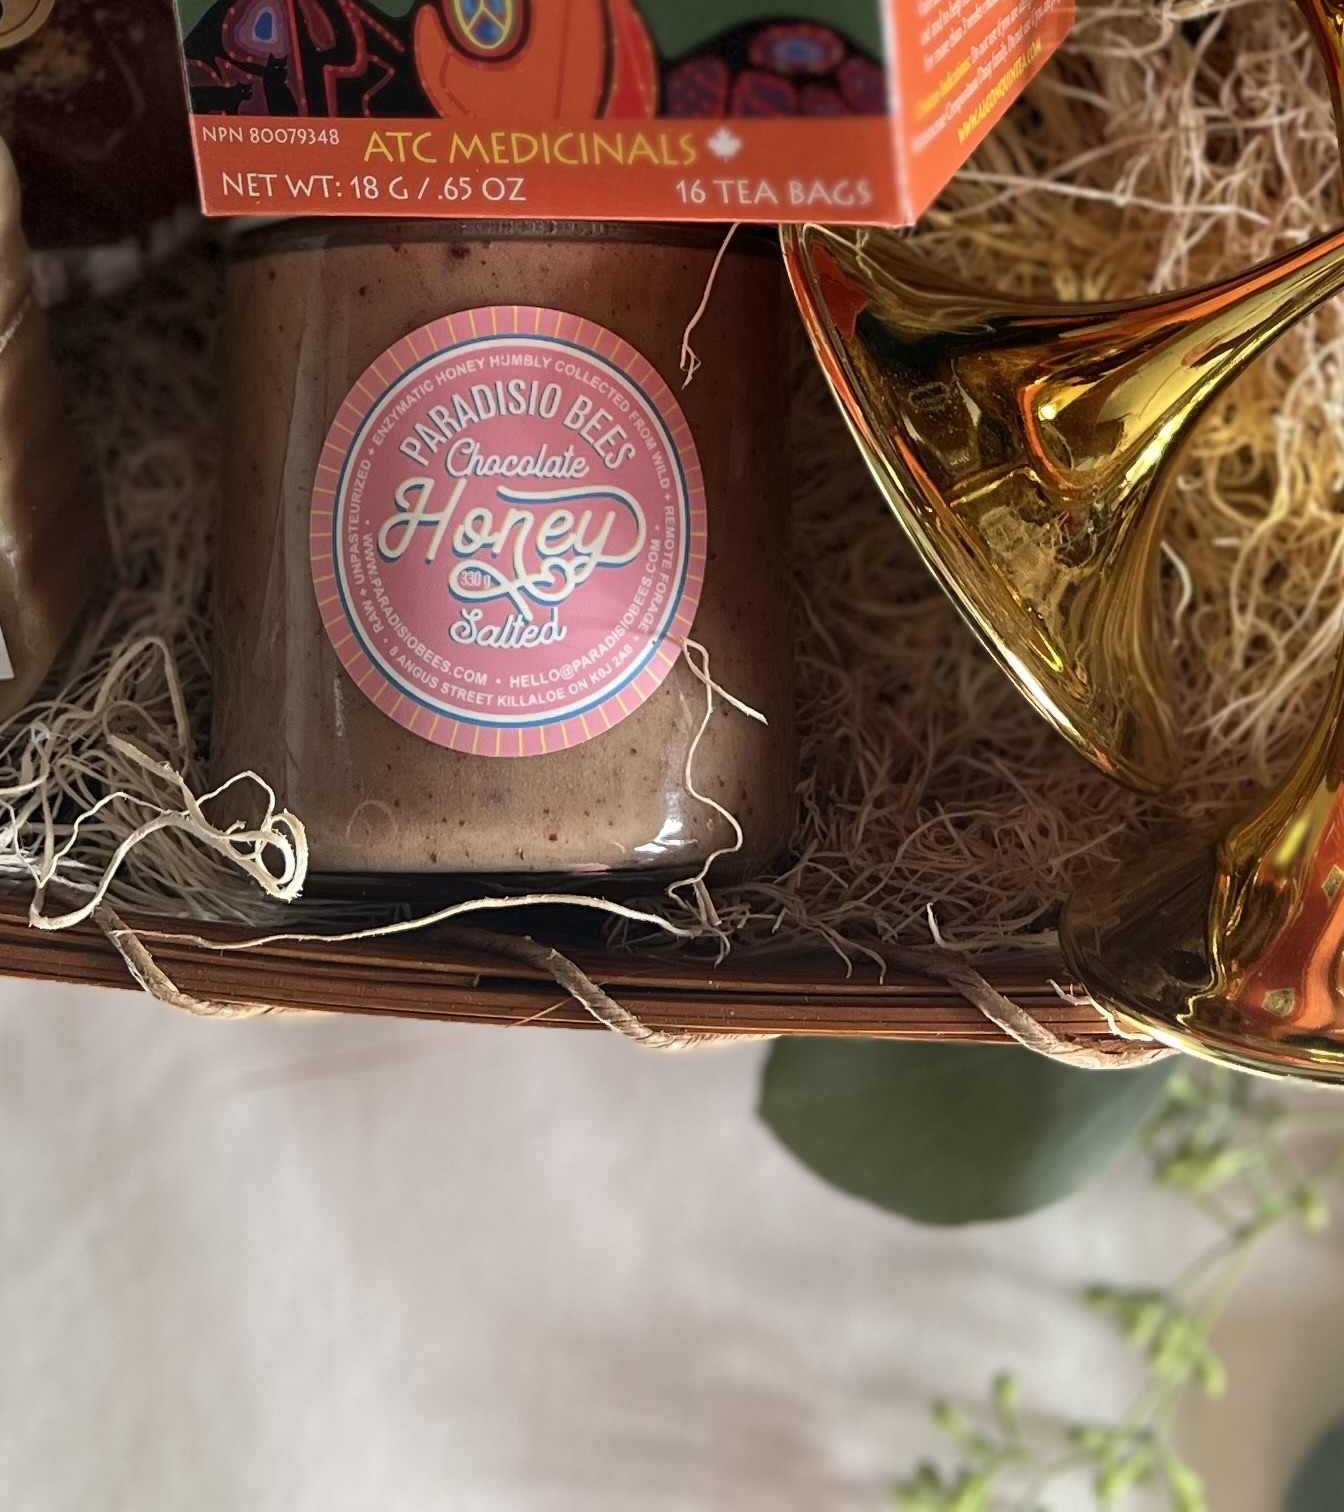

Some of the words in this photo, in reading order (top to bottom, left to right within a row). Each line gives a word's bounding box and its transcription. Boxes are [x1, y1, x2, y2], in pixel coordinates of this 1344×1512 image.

[202, 126, 243, 143] NPN
[250, 127, 340, 145] 80079348
[364, 131, 437, 164] ATC
[449, 132, 697, 166] MEDICINALS
[222, 173, 277, 197] NET
[285, 174, 343, 198] WT:
[350, 176, 379, 199] 18
[389, 176, 409, 200] G
[437, 177, 472, 200] .65
[482, 177, 527, 201] OZ
[676, 178, 707, 204] 16
[713, 179, 778, 206] TEA
[790, 180, 873, 207] BAGS
[372, 380, 435, 446] ENZYMATIC
[435, 357, 486, 386] HONEY
[489, 354, 552, 369] HUMBLY
[555, 360, 630, 412] COLLECTED
[628, 409, 657, 451] FROM
[651, 450, 671, 489] WILD
[399, 378, 563, 468] PARADISIO
[562, 394, 637, 470] BEES
[445, 437, 590, 479] Chocolate
[348, 459, 372, 585] UNPASTEURIZED
[378, 475, 647, 610] Honey
[662, 505, 675, 569] REMOTE
[459, 570, 482, 587] 330
[637, 569, 670, 634] FORAGE
[361, 600, 385, 634] RAW
[363, 531, 488, 686] WWW.PARADISIOBEES.COM
[448, 607, 568, 649] Salted
[510, 538, 662, 689] HELLO@PARADISIOBEES.COM
[396, 653, 439, 689] ANGUS
[440, 680, 493, 706] STREET
[497, 690, 567, 708] KILLALOE
[568, 680, 589, 696] ON
